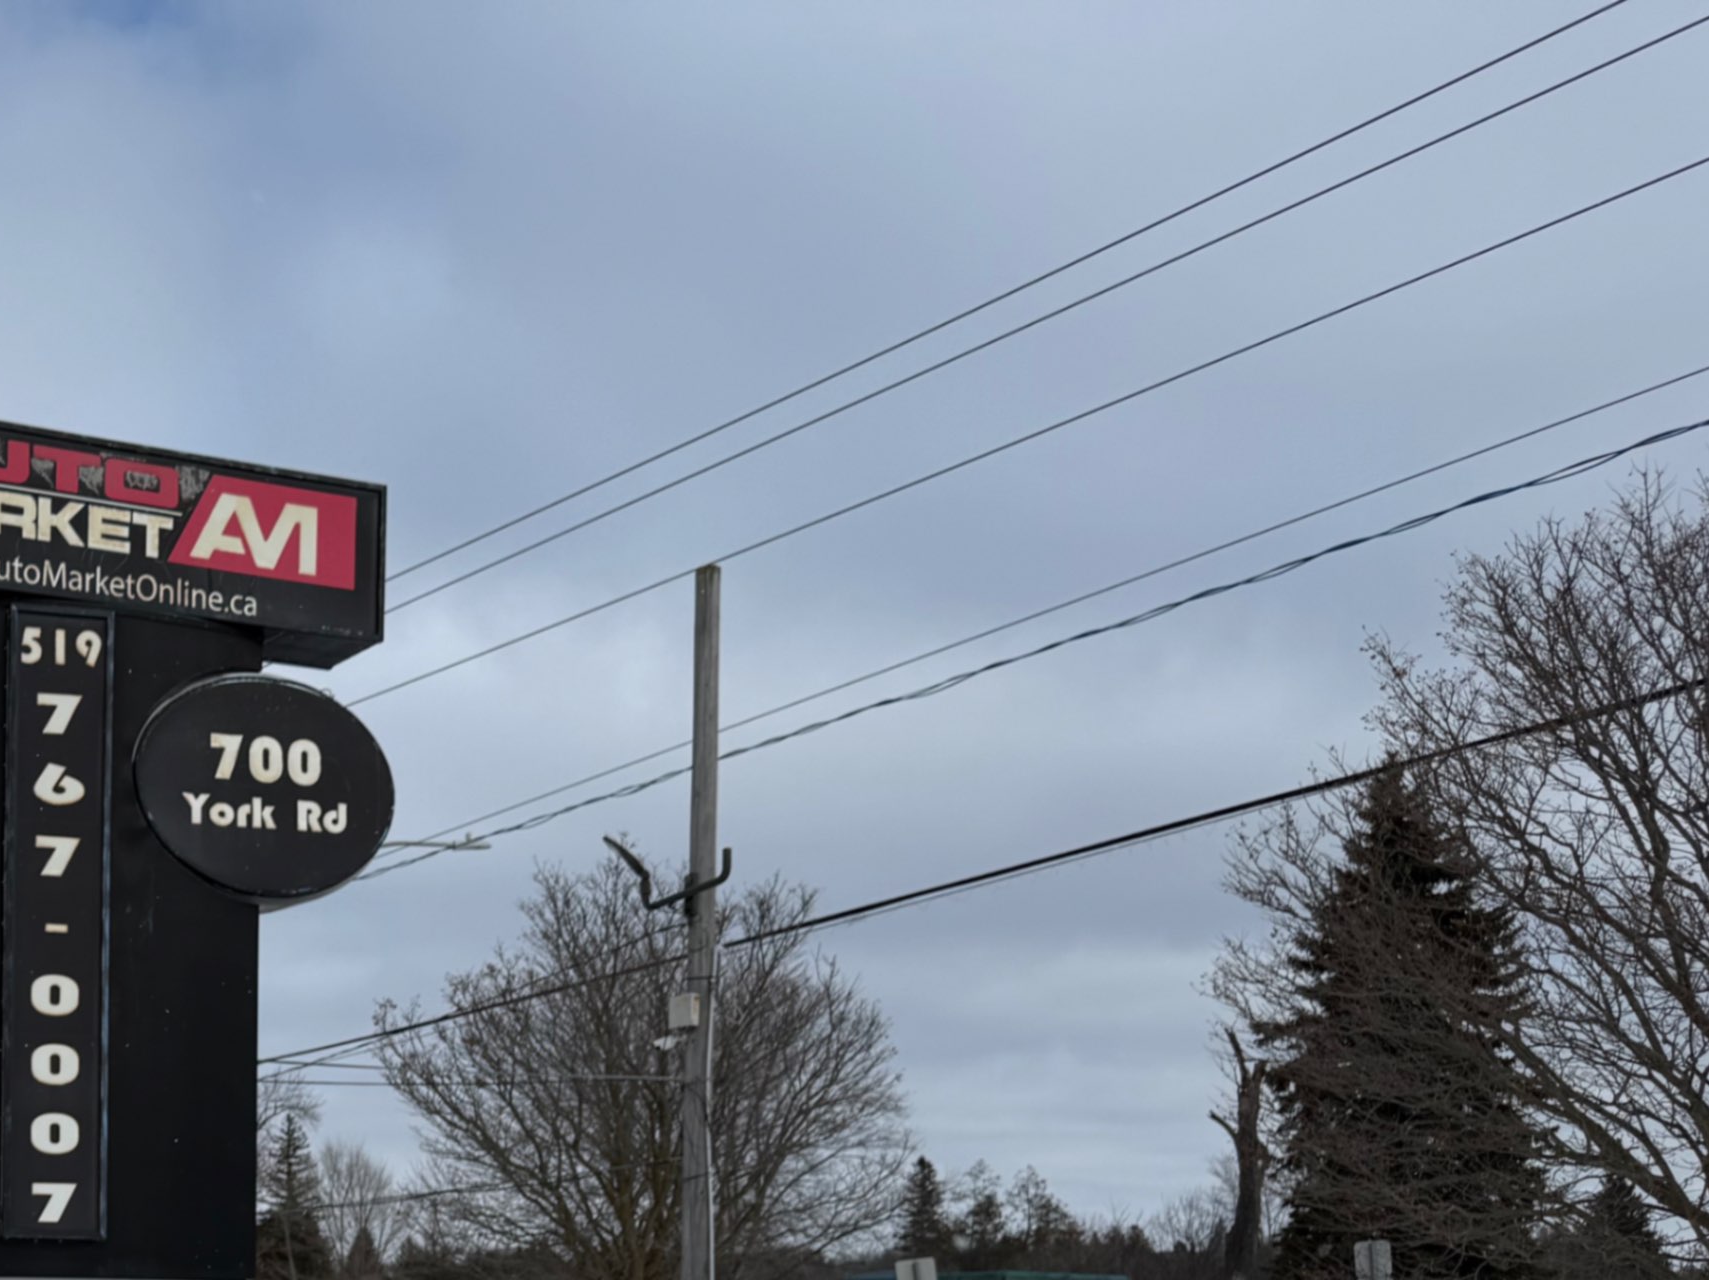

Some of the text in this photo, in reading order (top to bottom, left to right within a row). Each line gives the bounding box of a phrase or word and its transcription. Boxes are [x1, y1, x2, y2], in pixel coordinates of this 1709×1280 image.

[190, 493, 319, 577] AM
[21, 627, 103, 668] 519
[210, 732, 322, 787] 700
[182, 791, 348, 834] York Rd
